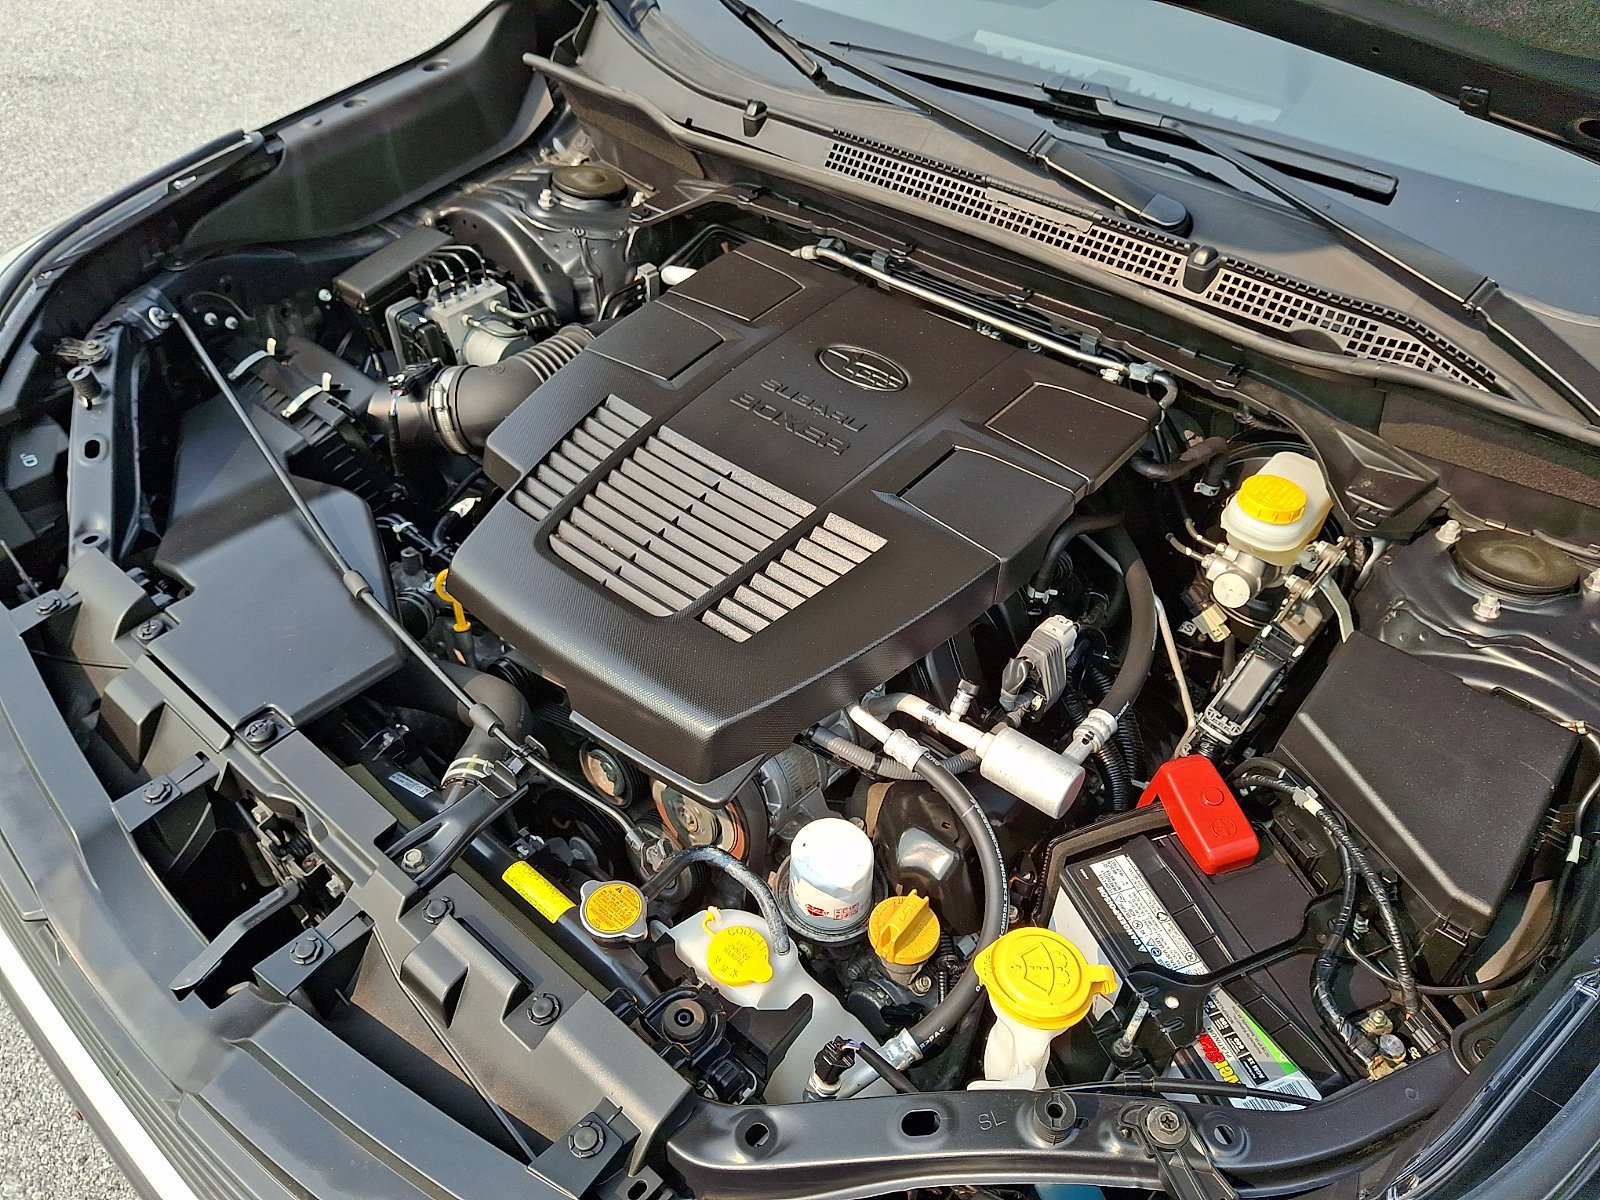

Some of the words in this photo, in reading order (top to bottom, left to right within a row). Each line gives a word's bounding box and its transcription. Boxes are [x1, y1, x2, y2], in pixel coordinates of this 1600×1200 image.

[761, 379, 867, 432] SUBARU
[729, 393, 850, 456] BOXER
[1252, 1063, 1265, 1079] AGM
[978, 1110, 1007, 1132] SL
